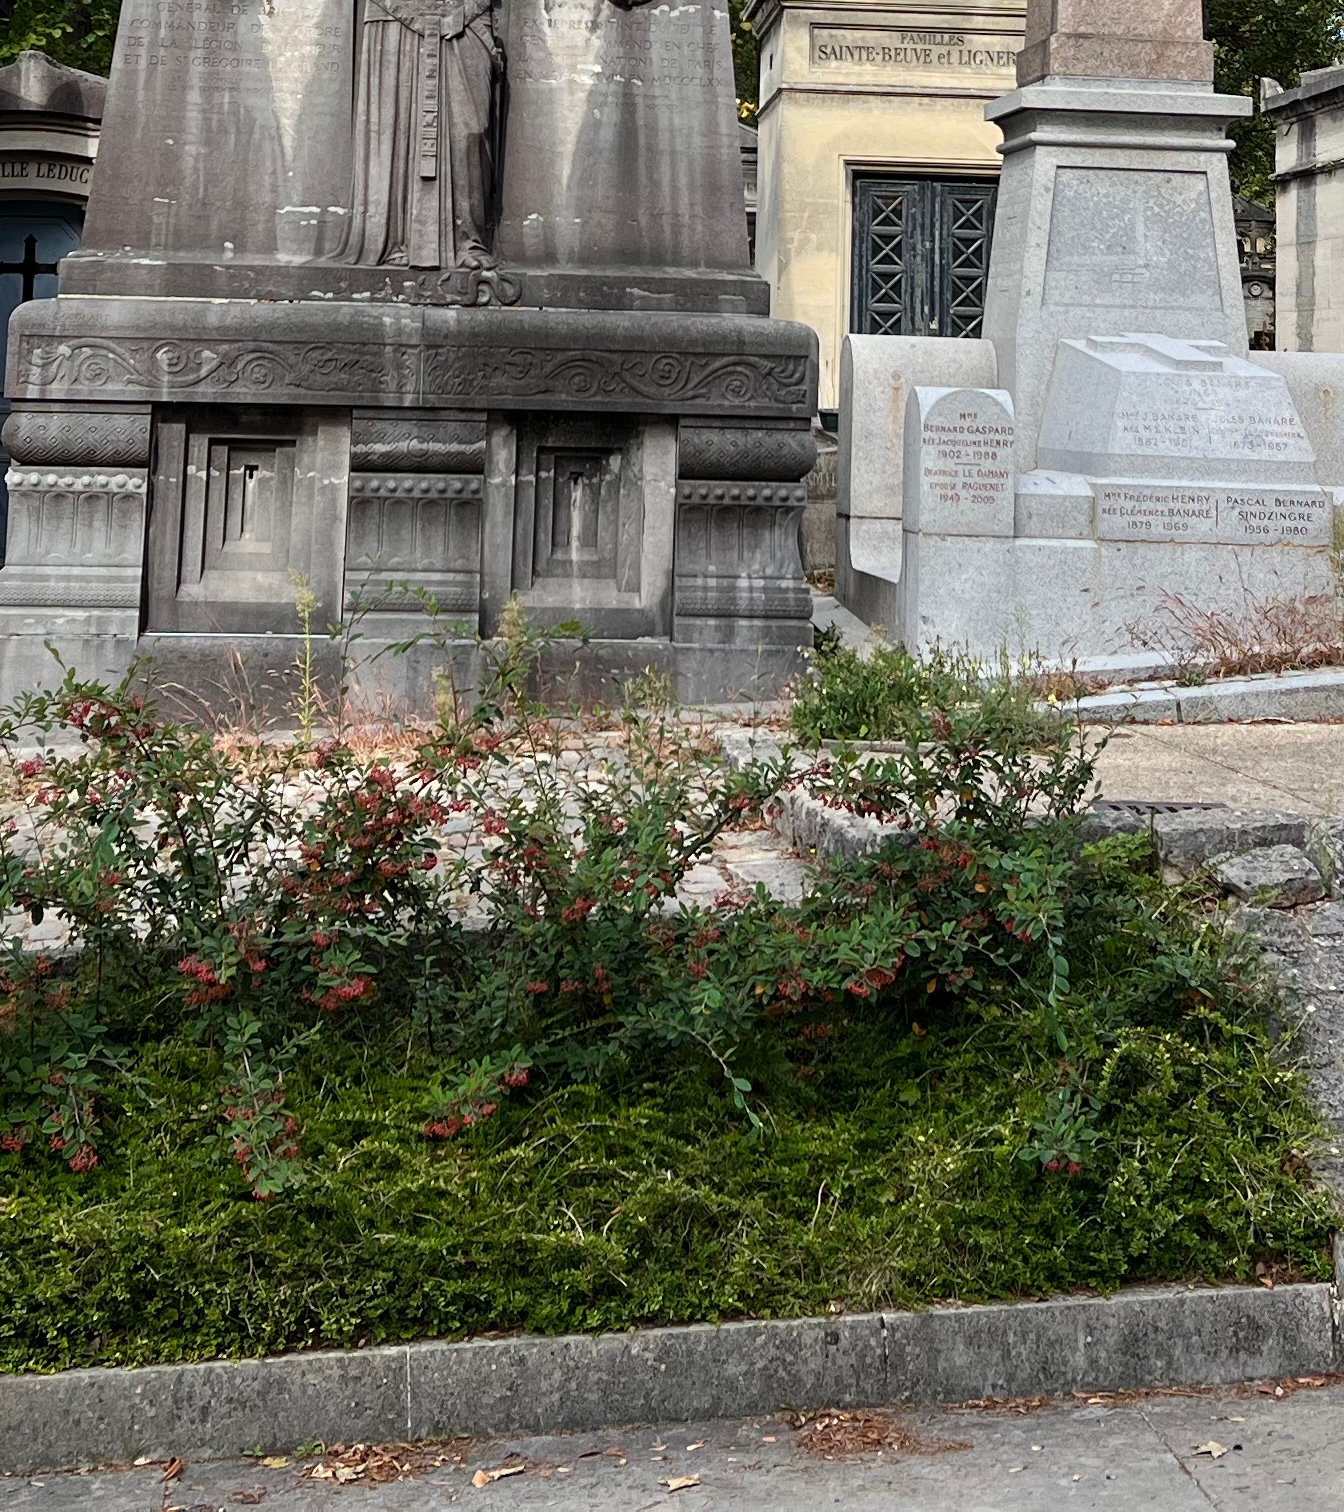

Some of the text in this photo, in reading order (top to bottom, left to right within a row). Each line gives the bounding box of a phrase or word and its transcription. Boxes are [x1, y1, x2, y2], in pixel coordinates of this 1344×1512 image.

[230, 4, 249, 16] DE
[129, 18, 236, 34] COMMANDEUR
[127, 35, 145, 48] DE
[160, 37, 178, 49] LA
[900, 33, 966, 47] FAMILLES
[665, 41, 681, 52] EN
[686, 41, 721, 54] CHEF
[124, 53, 140, 65] ET
[149, 54, 169, 66] DE
[817, 44, 933, 65] SAINTE-BEUVE
[937, 50, 952, 65] et
[661, 57, 678, 69] DE
[687, 59, 723, 70] PARIS
[35, 162, 90, 184] LEDUC
[923, 424, 1015, 436] BERNARD GASPARD
[983, 439, 1015, 449] HENRY
[938, 450, 962, 460] 1902
[963, 469, 974, 478] LE
[962, 482, 1006, 493] RAGUENET
[1171, 494, 1211, 505] HENRY
[1226, 496, 1326, 510] PASCAL BERNARD
[1238, 510, 1314, 522] SINDZINGRE
[1127, 520, 1152, 530] 1879
[1162, 521, 1189, 532] 1969
[1281, 525, 1308, 536] 1980
